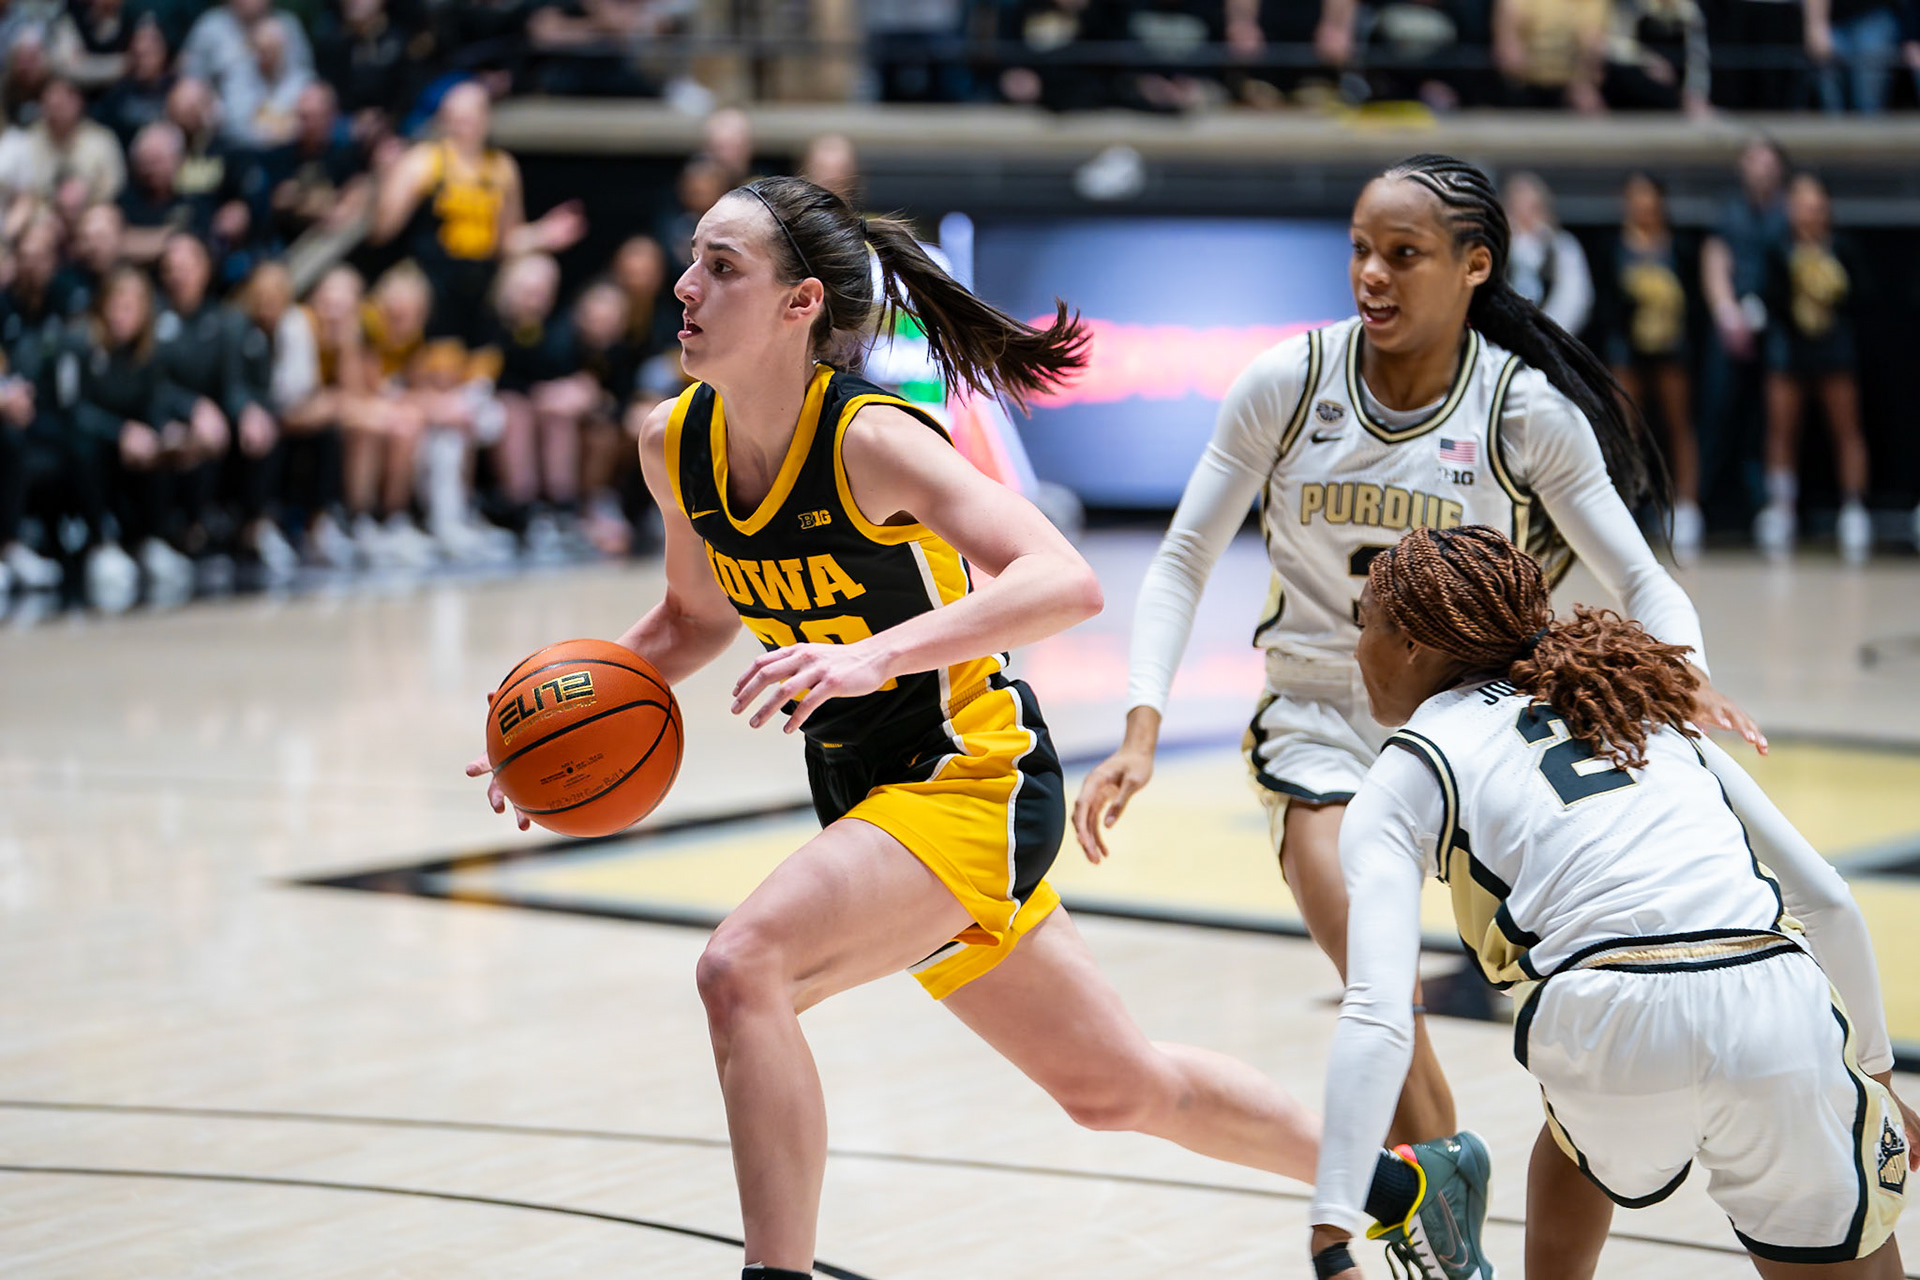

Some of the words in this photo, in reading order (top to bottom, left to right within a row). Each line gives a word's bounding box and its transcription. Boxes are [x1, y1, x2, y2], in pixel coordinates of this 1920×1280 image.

[1300, 481, 1463, 531] PURDUE
[498, 671, 595, 737] ELITE
[1513, 702, 1639, 809] 2
